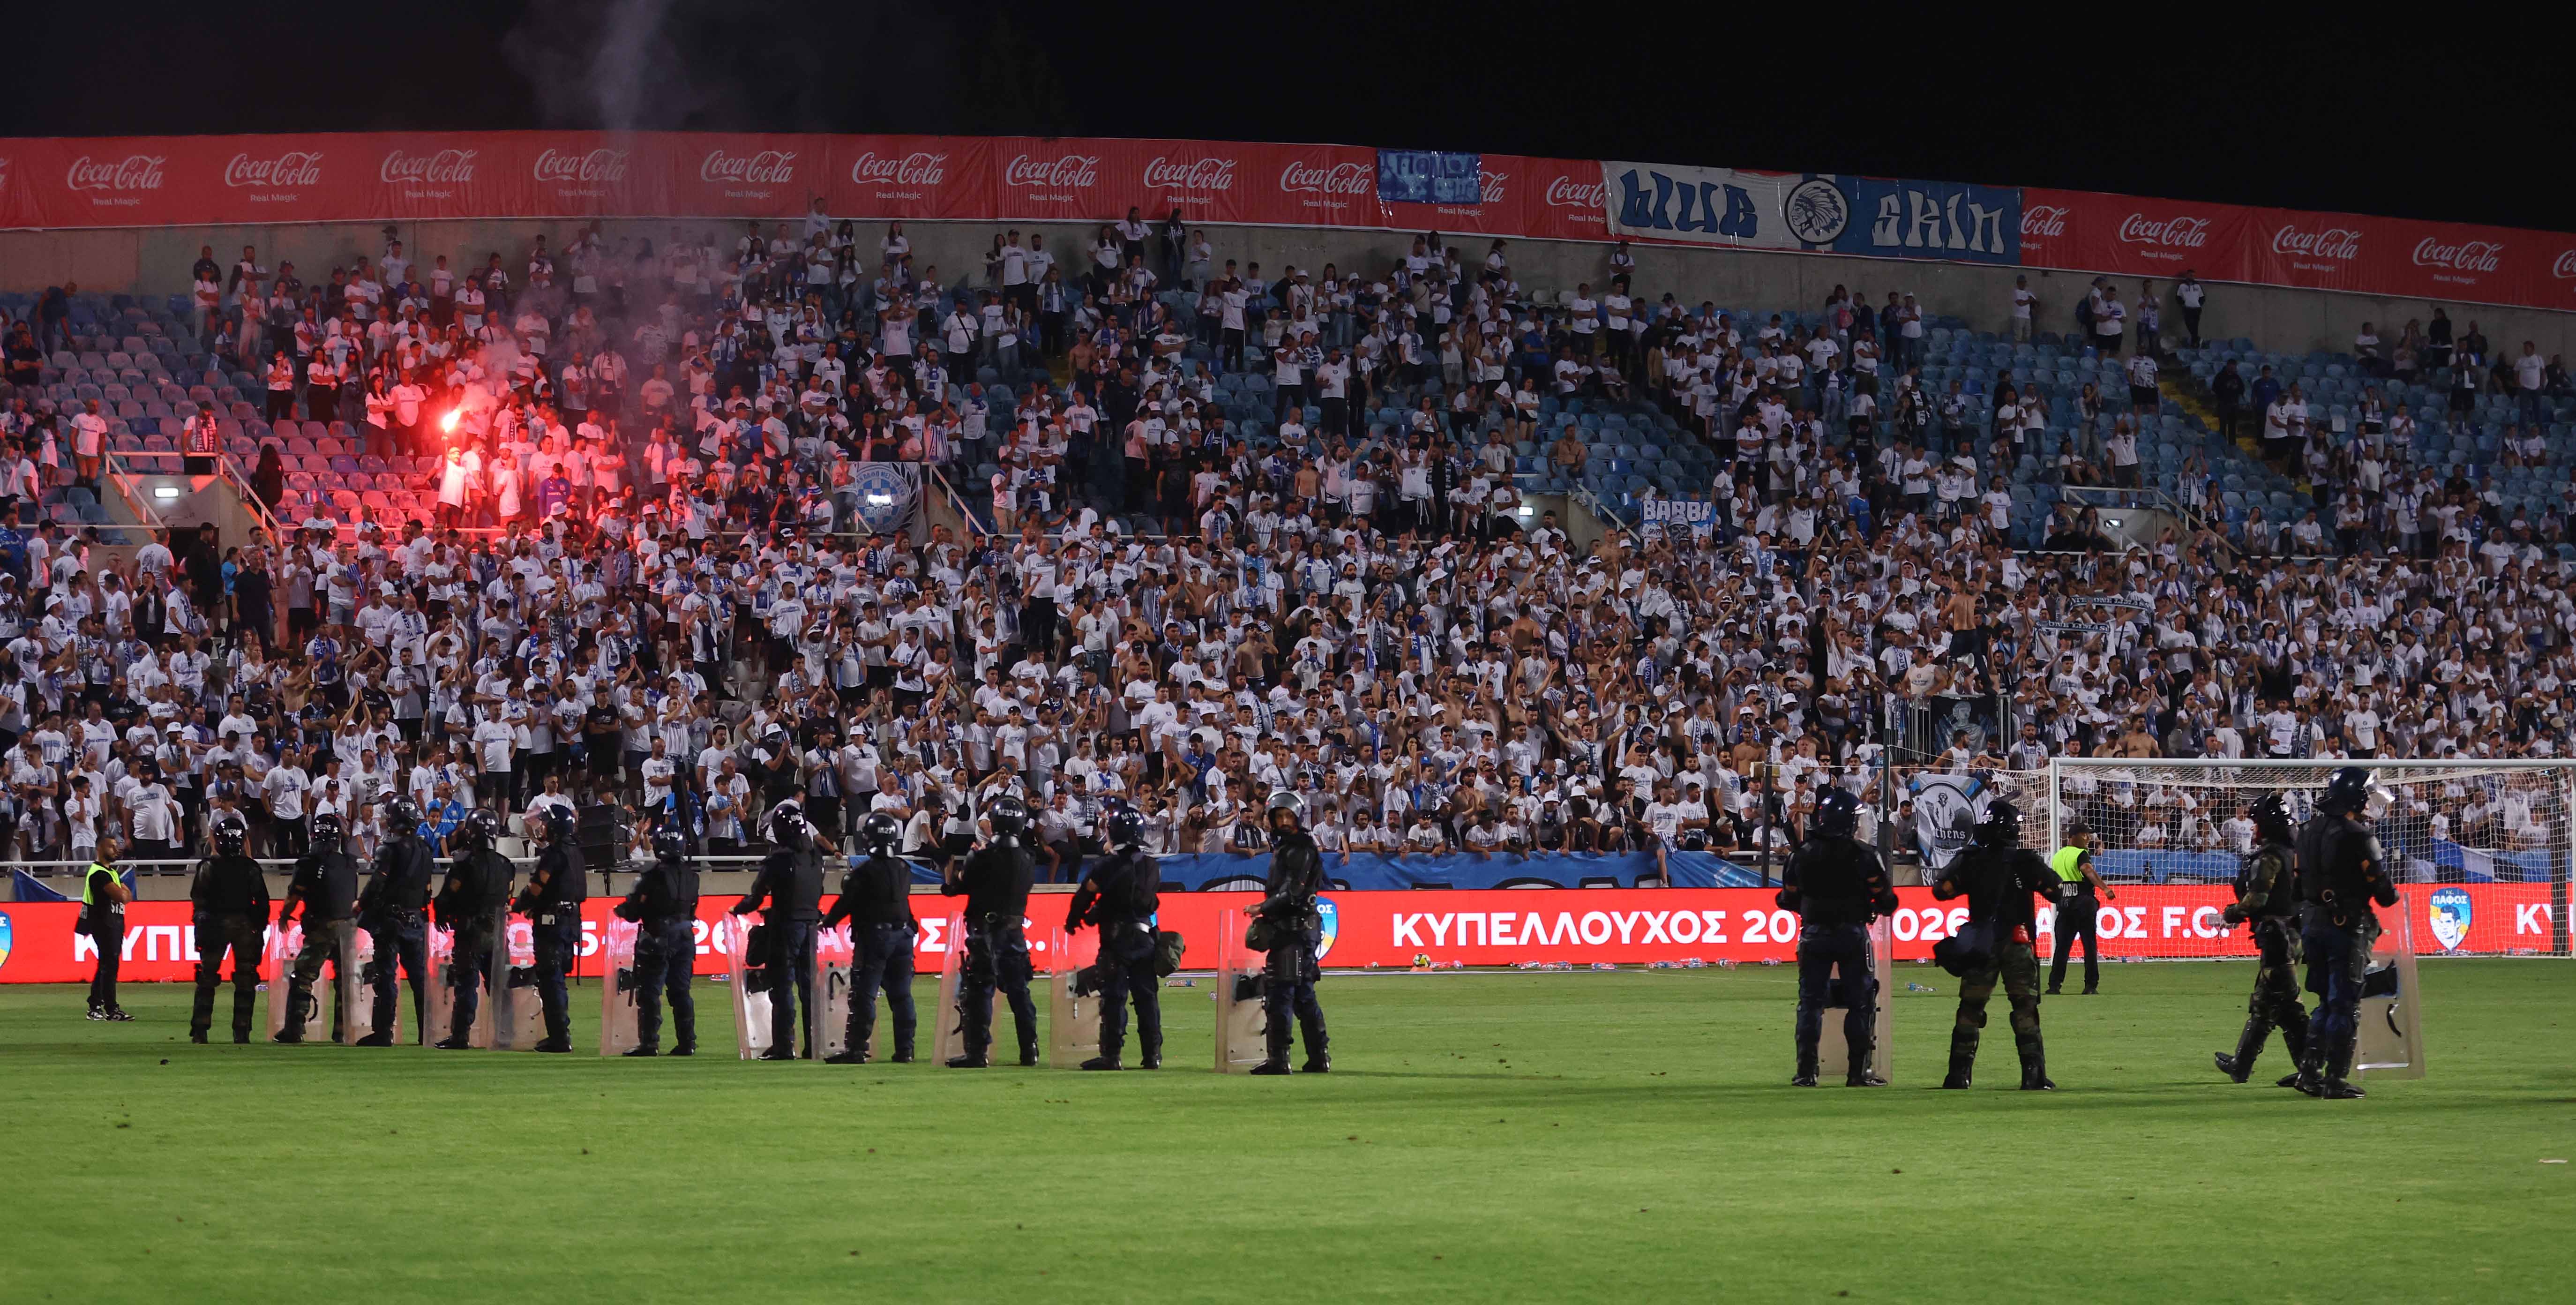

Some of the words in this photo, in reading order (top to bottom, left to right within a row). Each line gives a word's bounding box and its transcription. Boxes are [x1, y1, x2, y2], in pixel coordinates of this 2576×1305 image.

[271, 194, 298, 203] Magic
[427, 190, 451, 199] Magic
[746, 190, 771, 199] Magic
[897, 192, 921, 200] Magic
[1049, 194, 1074, 202] Magic
[114, 198, 140, 206] Magic
[1324, 200, 1348, 209] Magic
[1459, 208, 1482, 216] Magic
[1588, 215, 1605, 224] Mag
[2160, 252, 2184, 261] Magic
[2312, 263, 2336, 272] Magic
[2453, 275, 2476, 285] Magic
[1935, 827, 1965, 840] thens
[1393, 910, 1727, 948] ΚΥΠΕΛΛΟΥΧΟΣ
